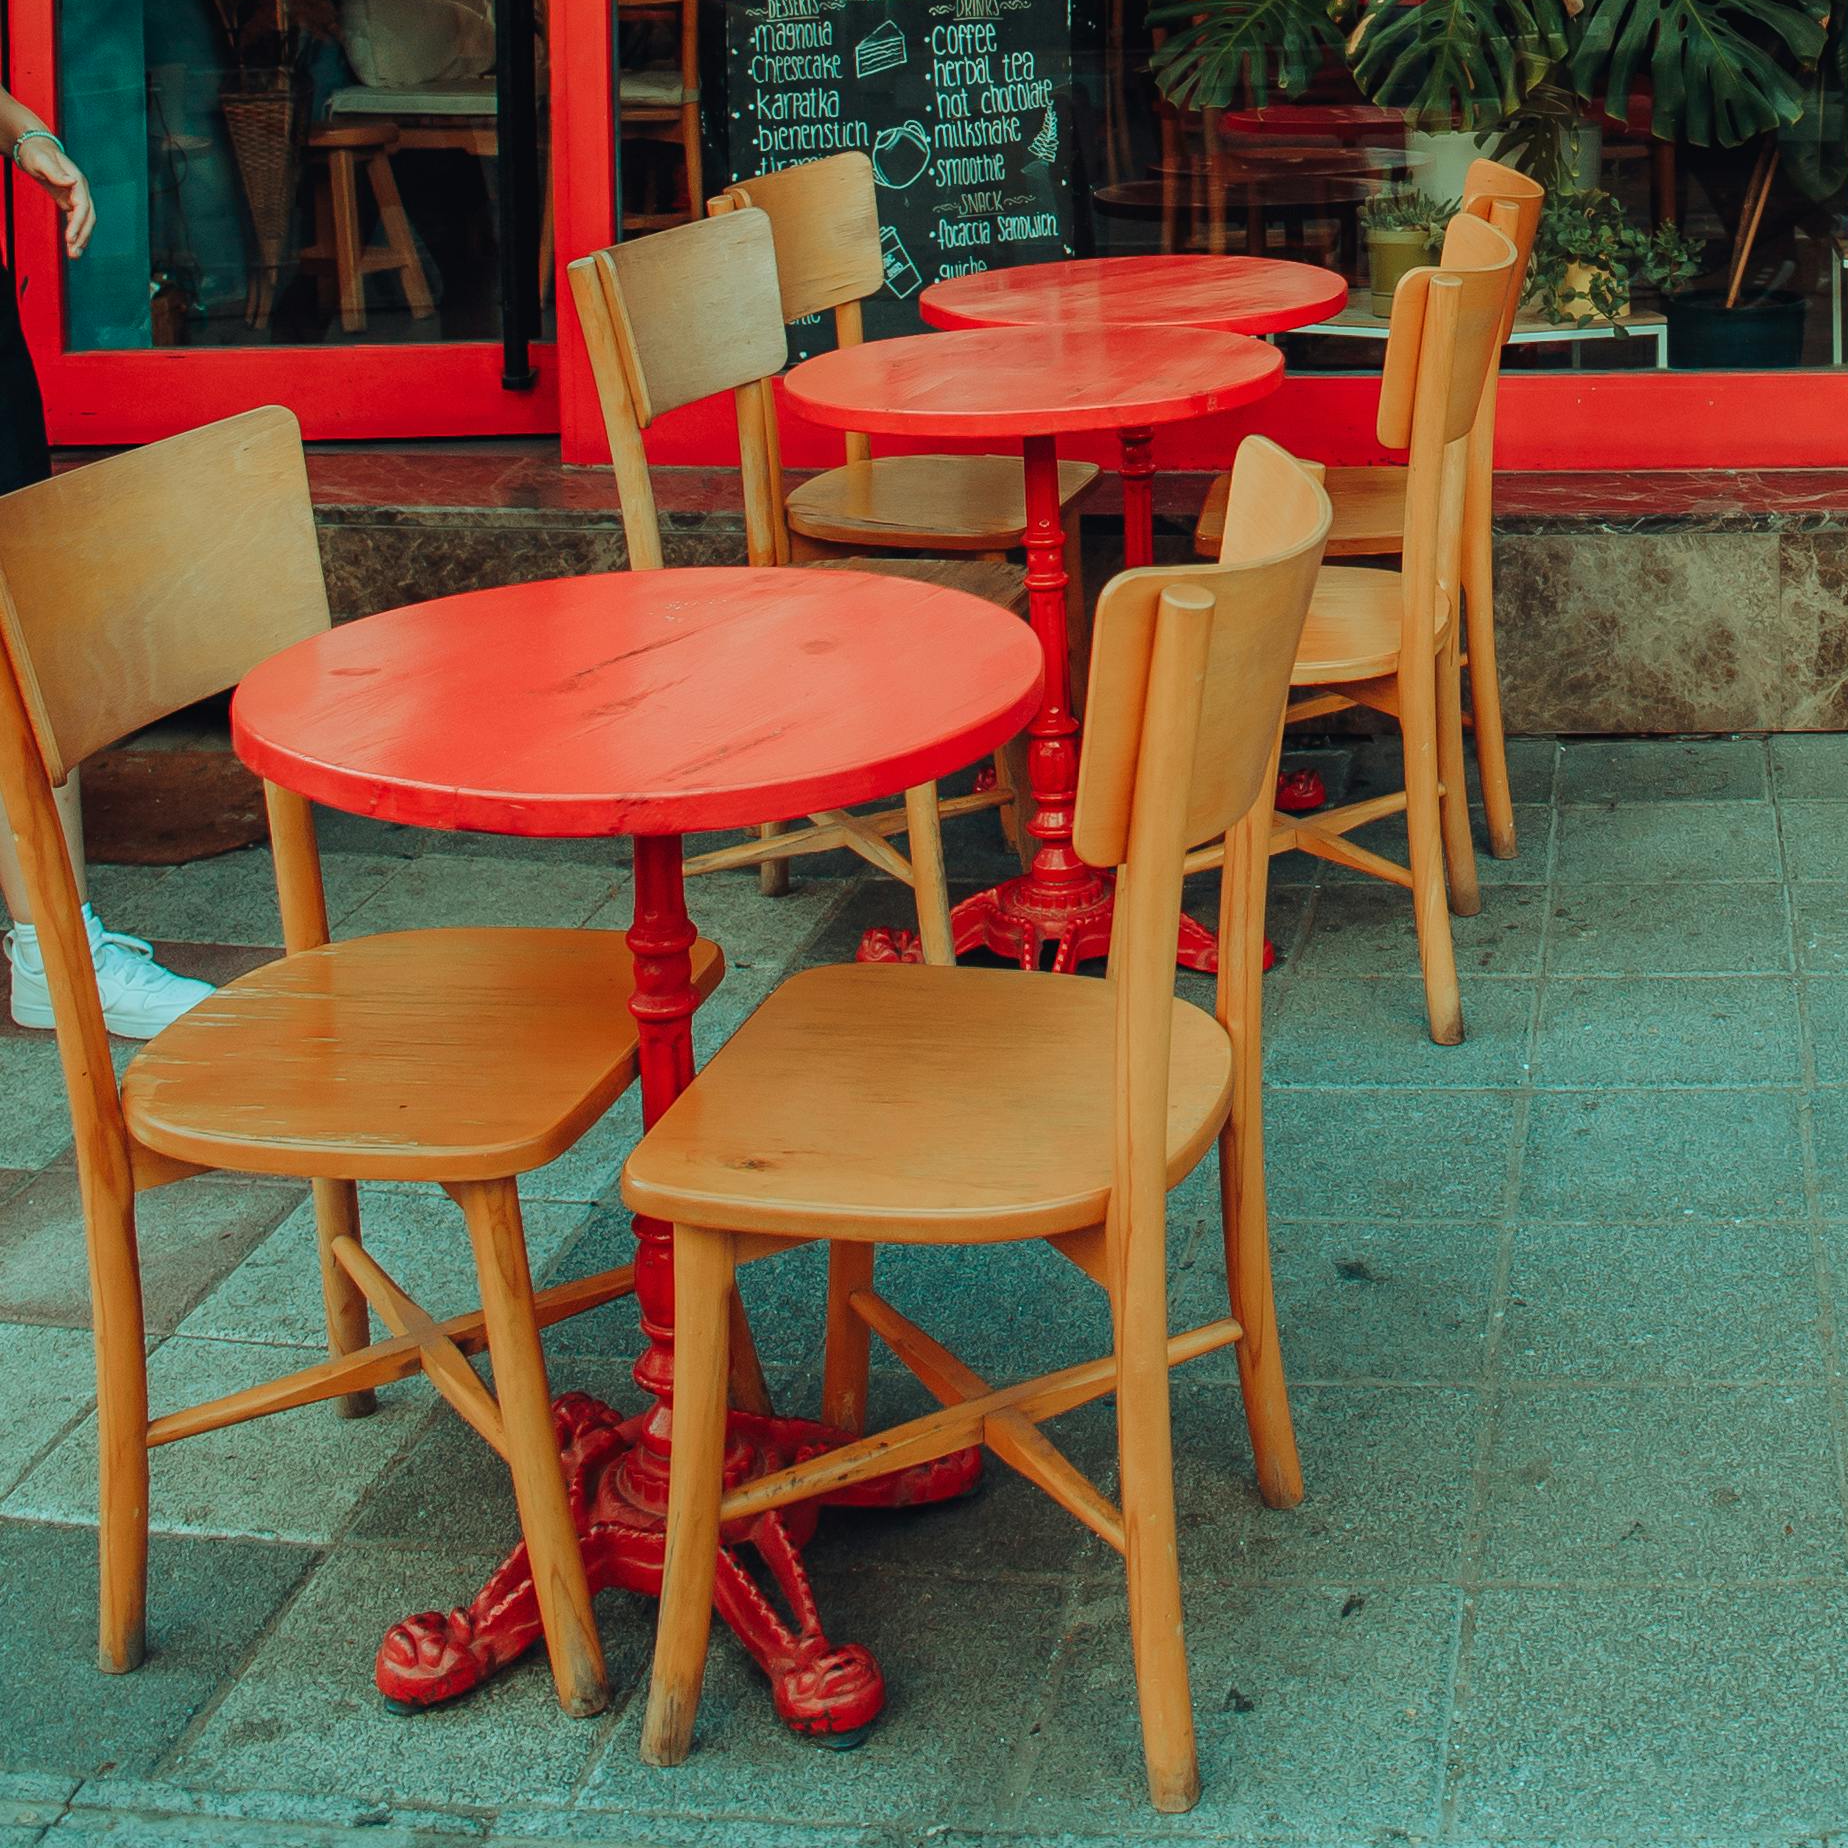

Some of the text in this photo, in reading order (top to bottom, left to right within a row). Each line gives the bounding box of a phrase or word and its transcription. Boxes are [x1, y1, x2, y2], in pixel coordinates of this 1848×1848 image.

[754, 21, 833, 52] magnolia
[934, 51, 1035, 87] herbal tea
[757, 88, 840, 120] karpatka
[936, 78, 1054, 120] hot chocolate
[758, 120, 869, 152] bienenstich
[934, 115, 1021, 148] milkshake
[935, 153, 1006, 187] smoothie
[958, 190, 1005, 215] SNACK
[937, 218, 991, 250] focaccia
